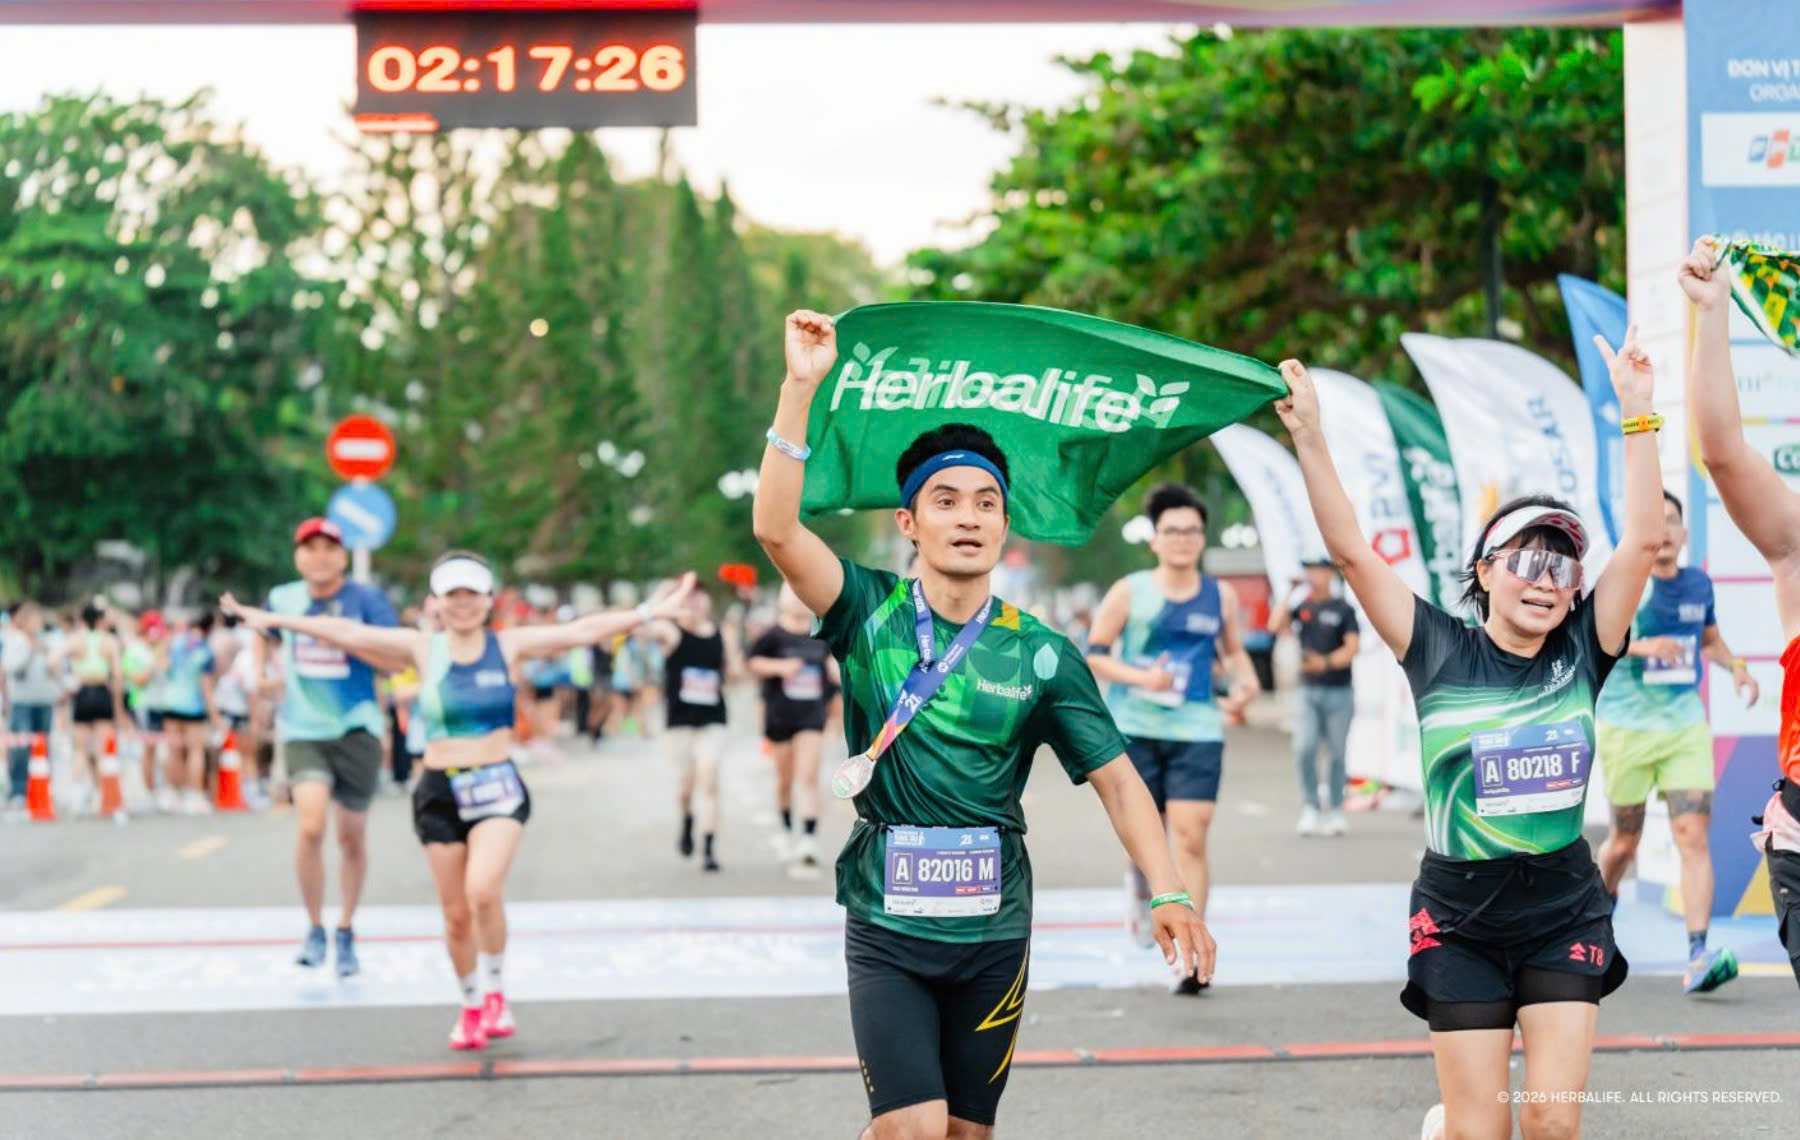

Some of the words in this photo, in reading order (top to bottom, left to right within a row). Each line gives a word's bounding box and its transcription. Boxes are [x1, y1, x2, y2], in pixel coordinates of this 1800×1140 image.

[368, 45, 686, 92] 02:17:26
[829, 356, 1142, 433] Herbalife
[977, 680, 1027, 701] Herbalife
[1485, 760, 1500, 783] A
[1507, 754, 1562, 781] 80218
[1571, 751, 1581, 774] F
[895, 858, 909, 880] A
[918, 858, 973, 882] 82016
[979, 856, 995, 880] M
[1588, 944, 1604, 967] T8
